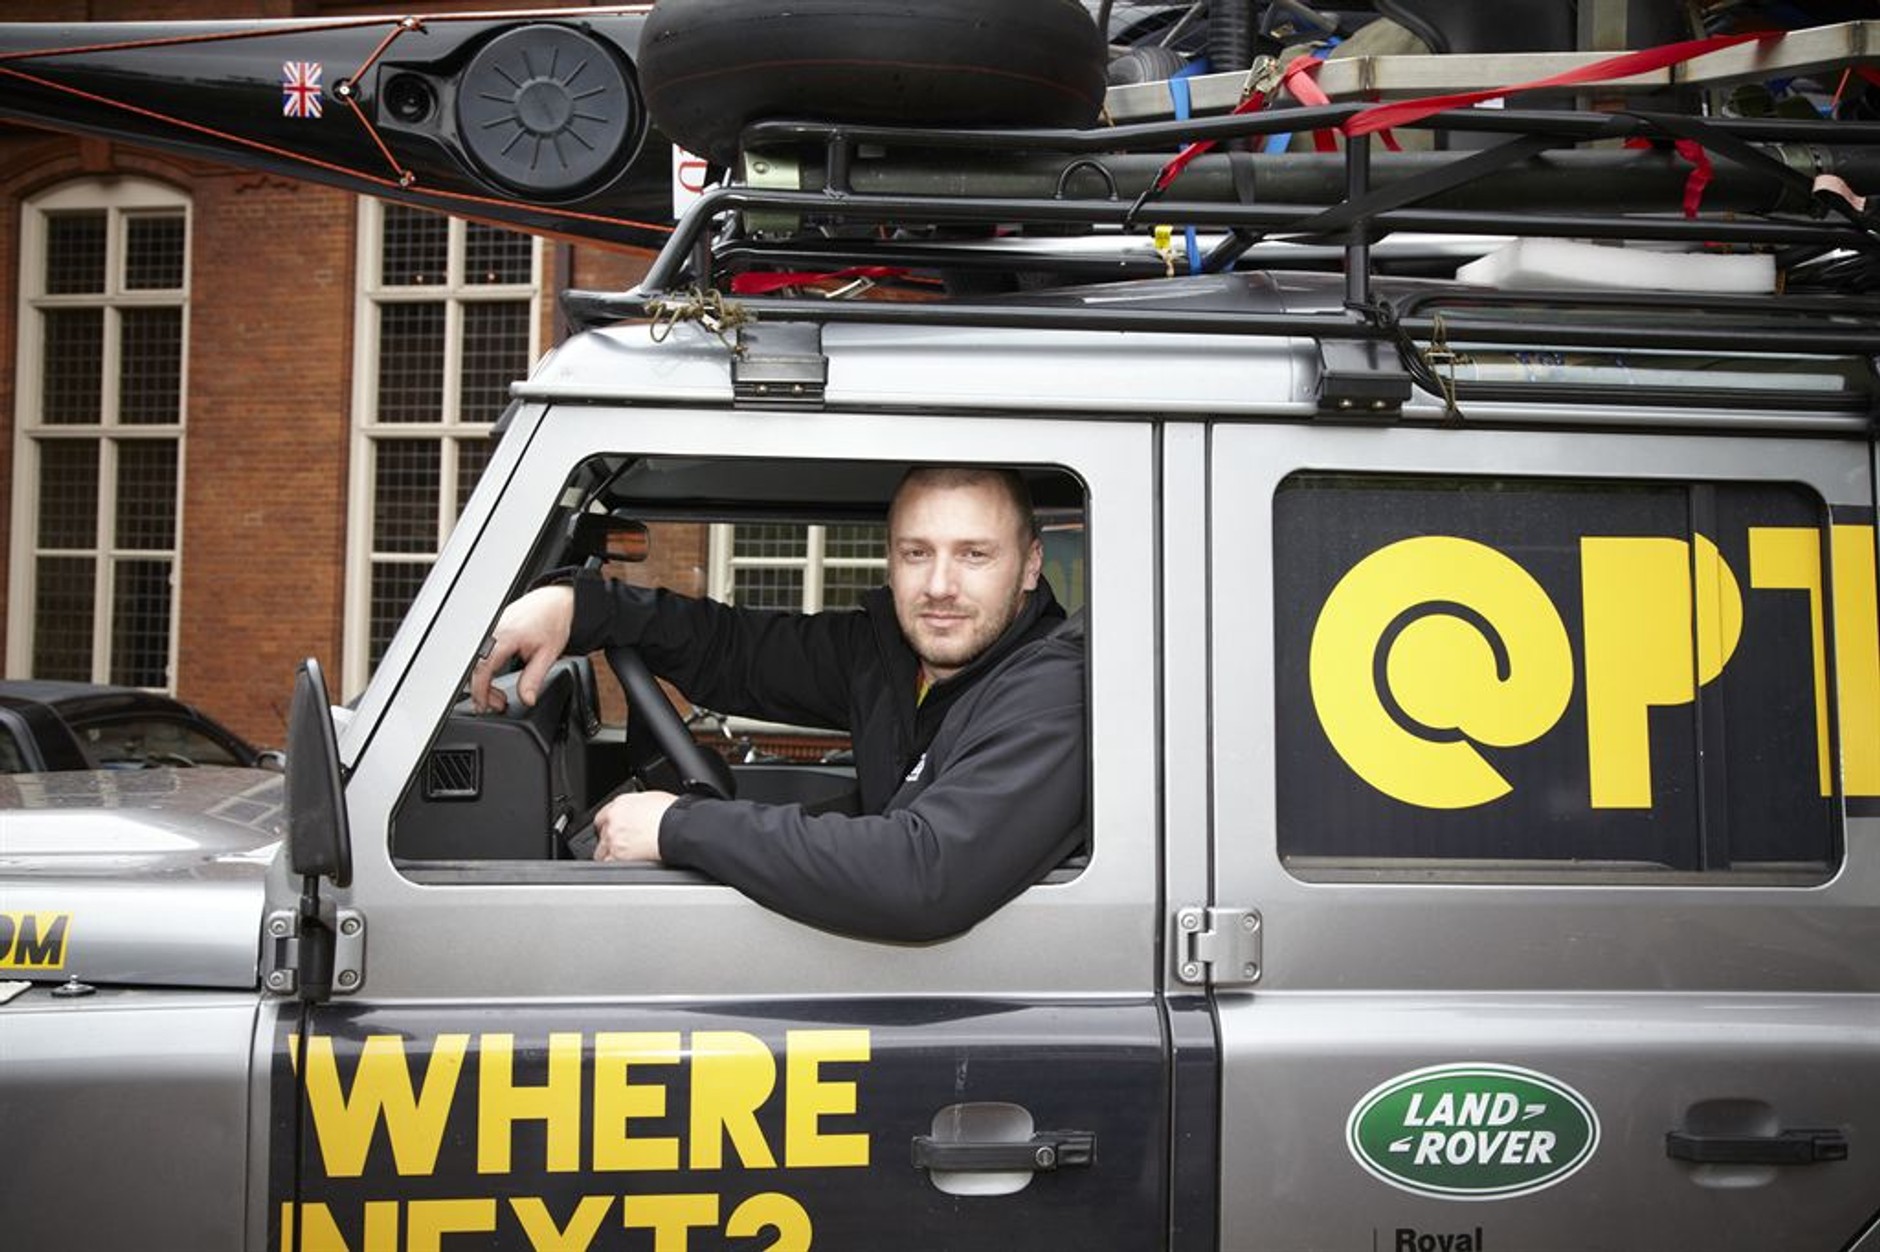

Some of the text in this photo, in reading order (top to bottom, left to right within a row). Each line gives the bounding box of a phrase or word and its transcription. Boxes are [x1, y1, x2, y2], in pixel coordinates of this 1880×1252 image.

[288, 1029, 871, 1178] WHERE
[1403, 1092, 1519, 1127] LAND
[1413, 1131, 1557, 1165] ROVER
